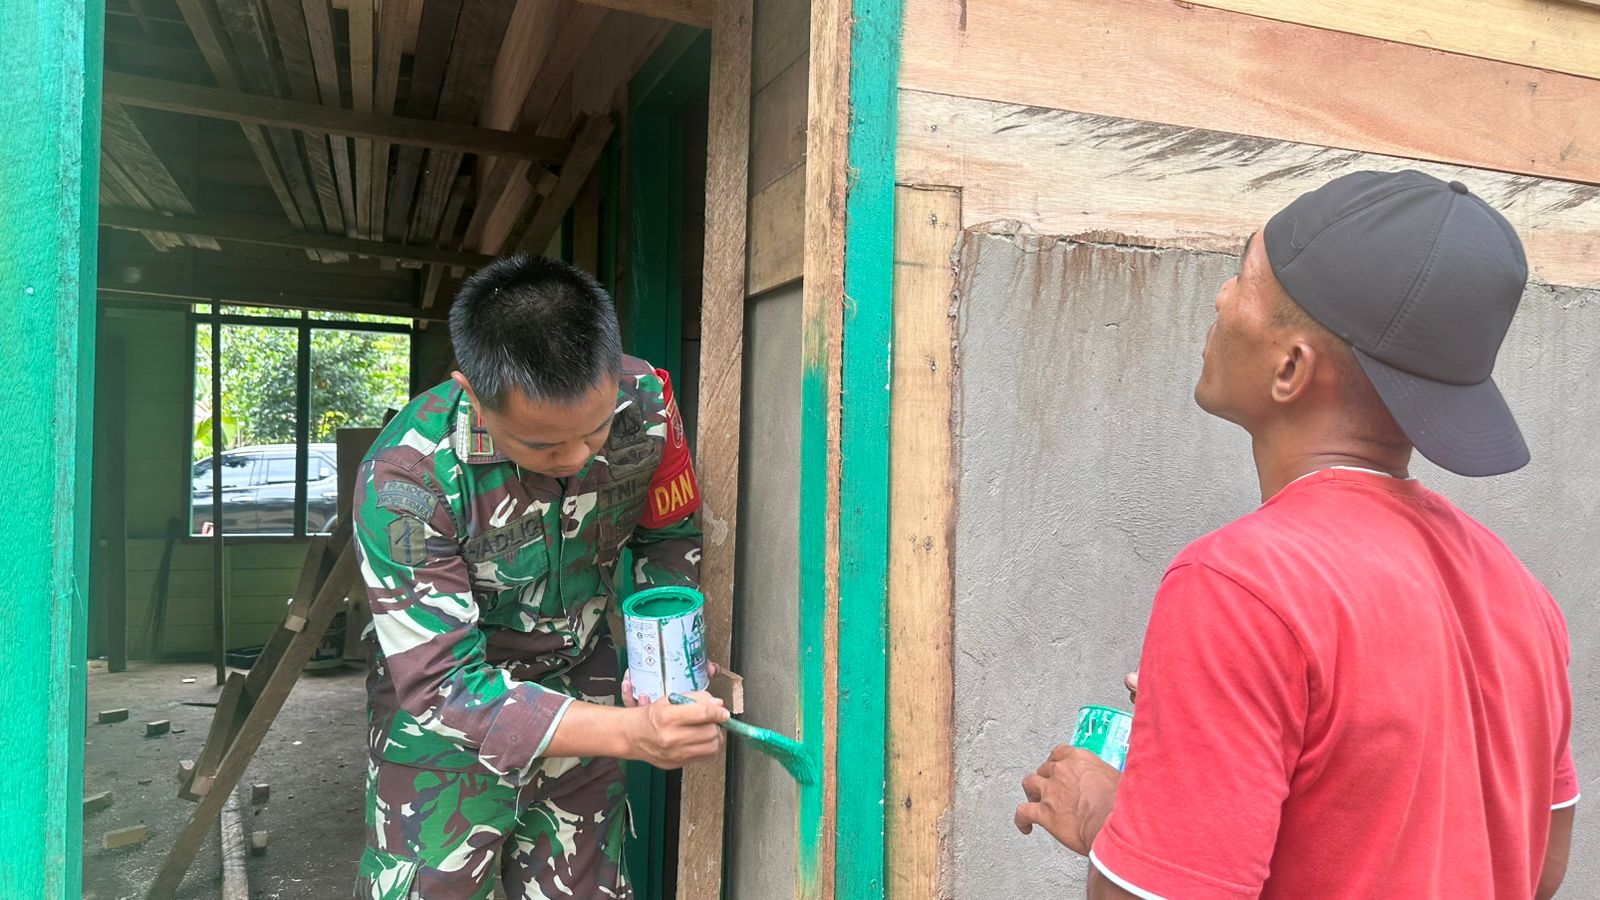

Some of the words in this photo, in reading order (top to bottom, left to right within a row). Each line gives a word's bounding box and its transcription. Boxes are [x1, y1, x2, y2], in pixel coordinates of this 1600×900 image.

[388, 482, 431, 504] RAIDER
[601, 480, 636, 505] TNI
[654, 469, 694, 516] DAN
[405, 498, 430, 518] UDARA
